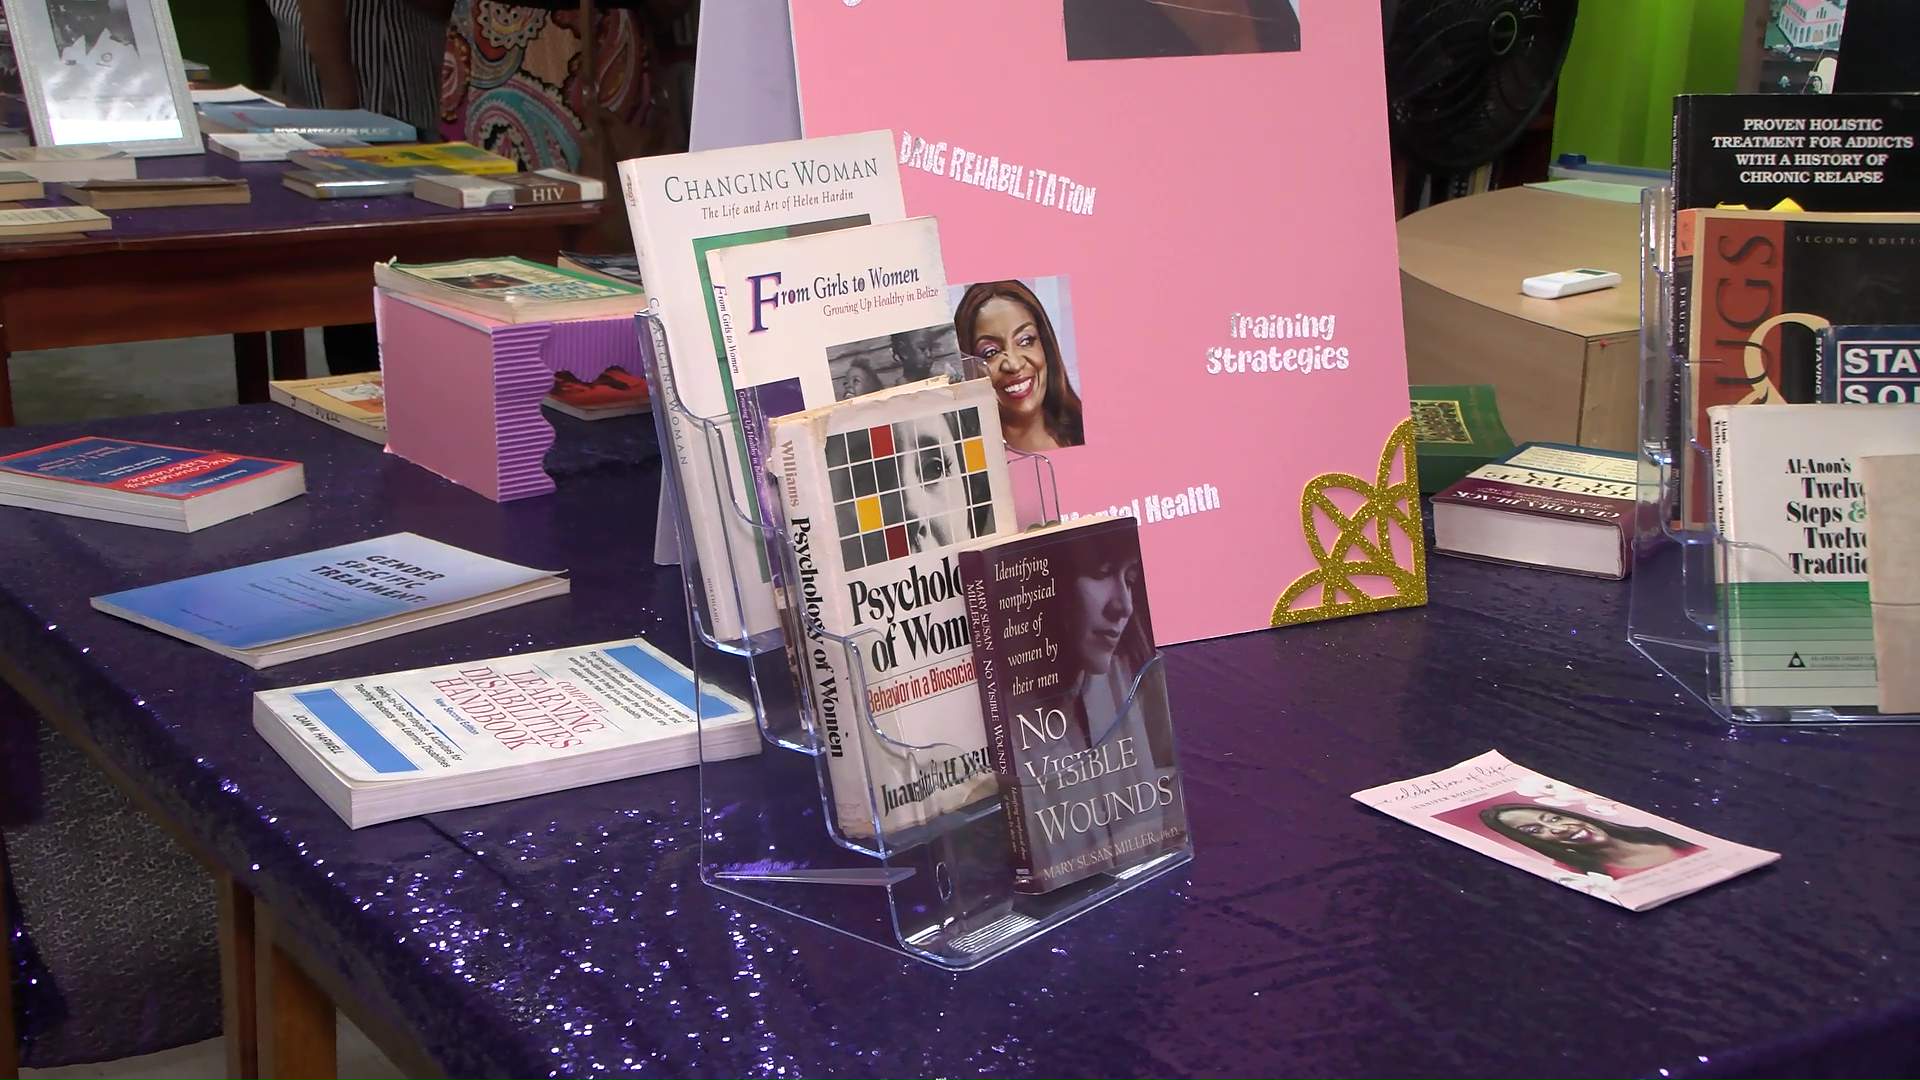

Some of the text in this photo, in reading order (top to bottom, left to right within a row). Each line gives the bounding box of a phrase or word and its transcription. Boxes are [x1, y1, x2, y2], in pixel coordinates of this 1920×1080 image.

[1712, 136, 1914, 149] TREATMENT FOR ADDICTS
[1743, 119, 1883, 131] PROVEN HOLISTIC
[900, 129, 947, 176] DRUG
[1735, 153, 1888, 167] WITH A HISTORY OF
[532, 188, 565, 202] HIV
[664, 169, 790, 203] CHANGING
[792, 157, 879, 186] WOMAN
[1739, 171, 1884, 184] CHRONIC RELAPSE
[702, 189, 854, 220] The Life and Art of Helen Hardin
[1795, 235, 1920, 245] SECOND EDITI
[745, 266, 919, 335] From Girls to Women
[823, 288, 939, 316] Growing Up Healthy in Belize
[1679, 286, 1688, 344] DRUGS
[714, 284, 739, 374] From Girls to Women
[1230, 312, 1336, 341] Training
[1206, 345, 1350, 375] Strategies
[669, 399, 688, 465] WOMAN
[1785, 457, 1852, 474] Al-Anon's
[1145, 483, 1221, 524] Health
[1452, 490, 1519, 506] BLACK
[1527, 500, 1621, 519] CLAUDIA
[1786, 501, 1868, 528] Steps &
[336, 560, 427, 589] SPECIFIC
[365, 555, 446, 581] GENDER
[994, 556, 1050, 583] Identifying
[780, 440, 844, 760] Williams Psychology of Women
[999, 578, 1056, 613] nonphysical
[975, 579, 994, 651] MARY SUSAN
[1003, 612, 1044, 640] abuse of
[871, 623, 899, 673] of
[1007, 637, 1059, 668] women by
[501, 670, 608, 733] LEARNING
[555, 681, 608, 713] COMPLETE
[867, 657, 977, 714] Behavior in a Biosocial
[1012, 672, 1060, 697] their men
[350, 684, 455, 767] Teaching Students with Learning Disabilities
[370, 686, 409, 711] Ready-to-Use
[400, 712, 432, 731] Strategies
[428, 736, 461, 756] Activities
[428, 677, 543, 750] HANDBOOK
[431, 698, 482, 734] New Second Edition
[457, 667, 587, 749] DISABILITIES
[983, 660, 1008, 775] NO VISIBLE WOUNDS
[292, 714, 315, 727] JOAN
[311, 732, 343, 754] HARWELL
[1016, 707, 1067, 751] NO
[1024, 737, 1138, 795] VISIBLE
[1034, 775, 1174, 845] WOUNDS
[1042, 858, 1074, 880] MARY
[1077, 847, 1113, 868] SUSAN
